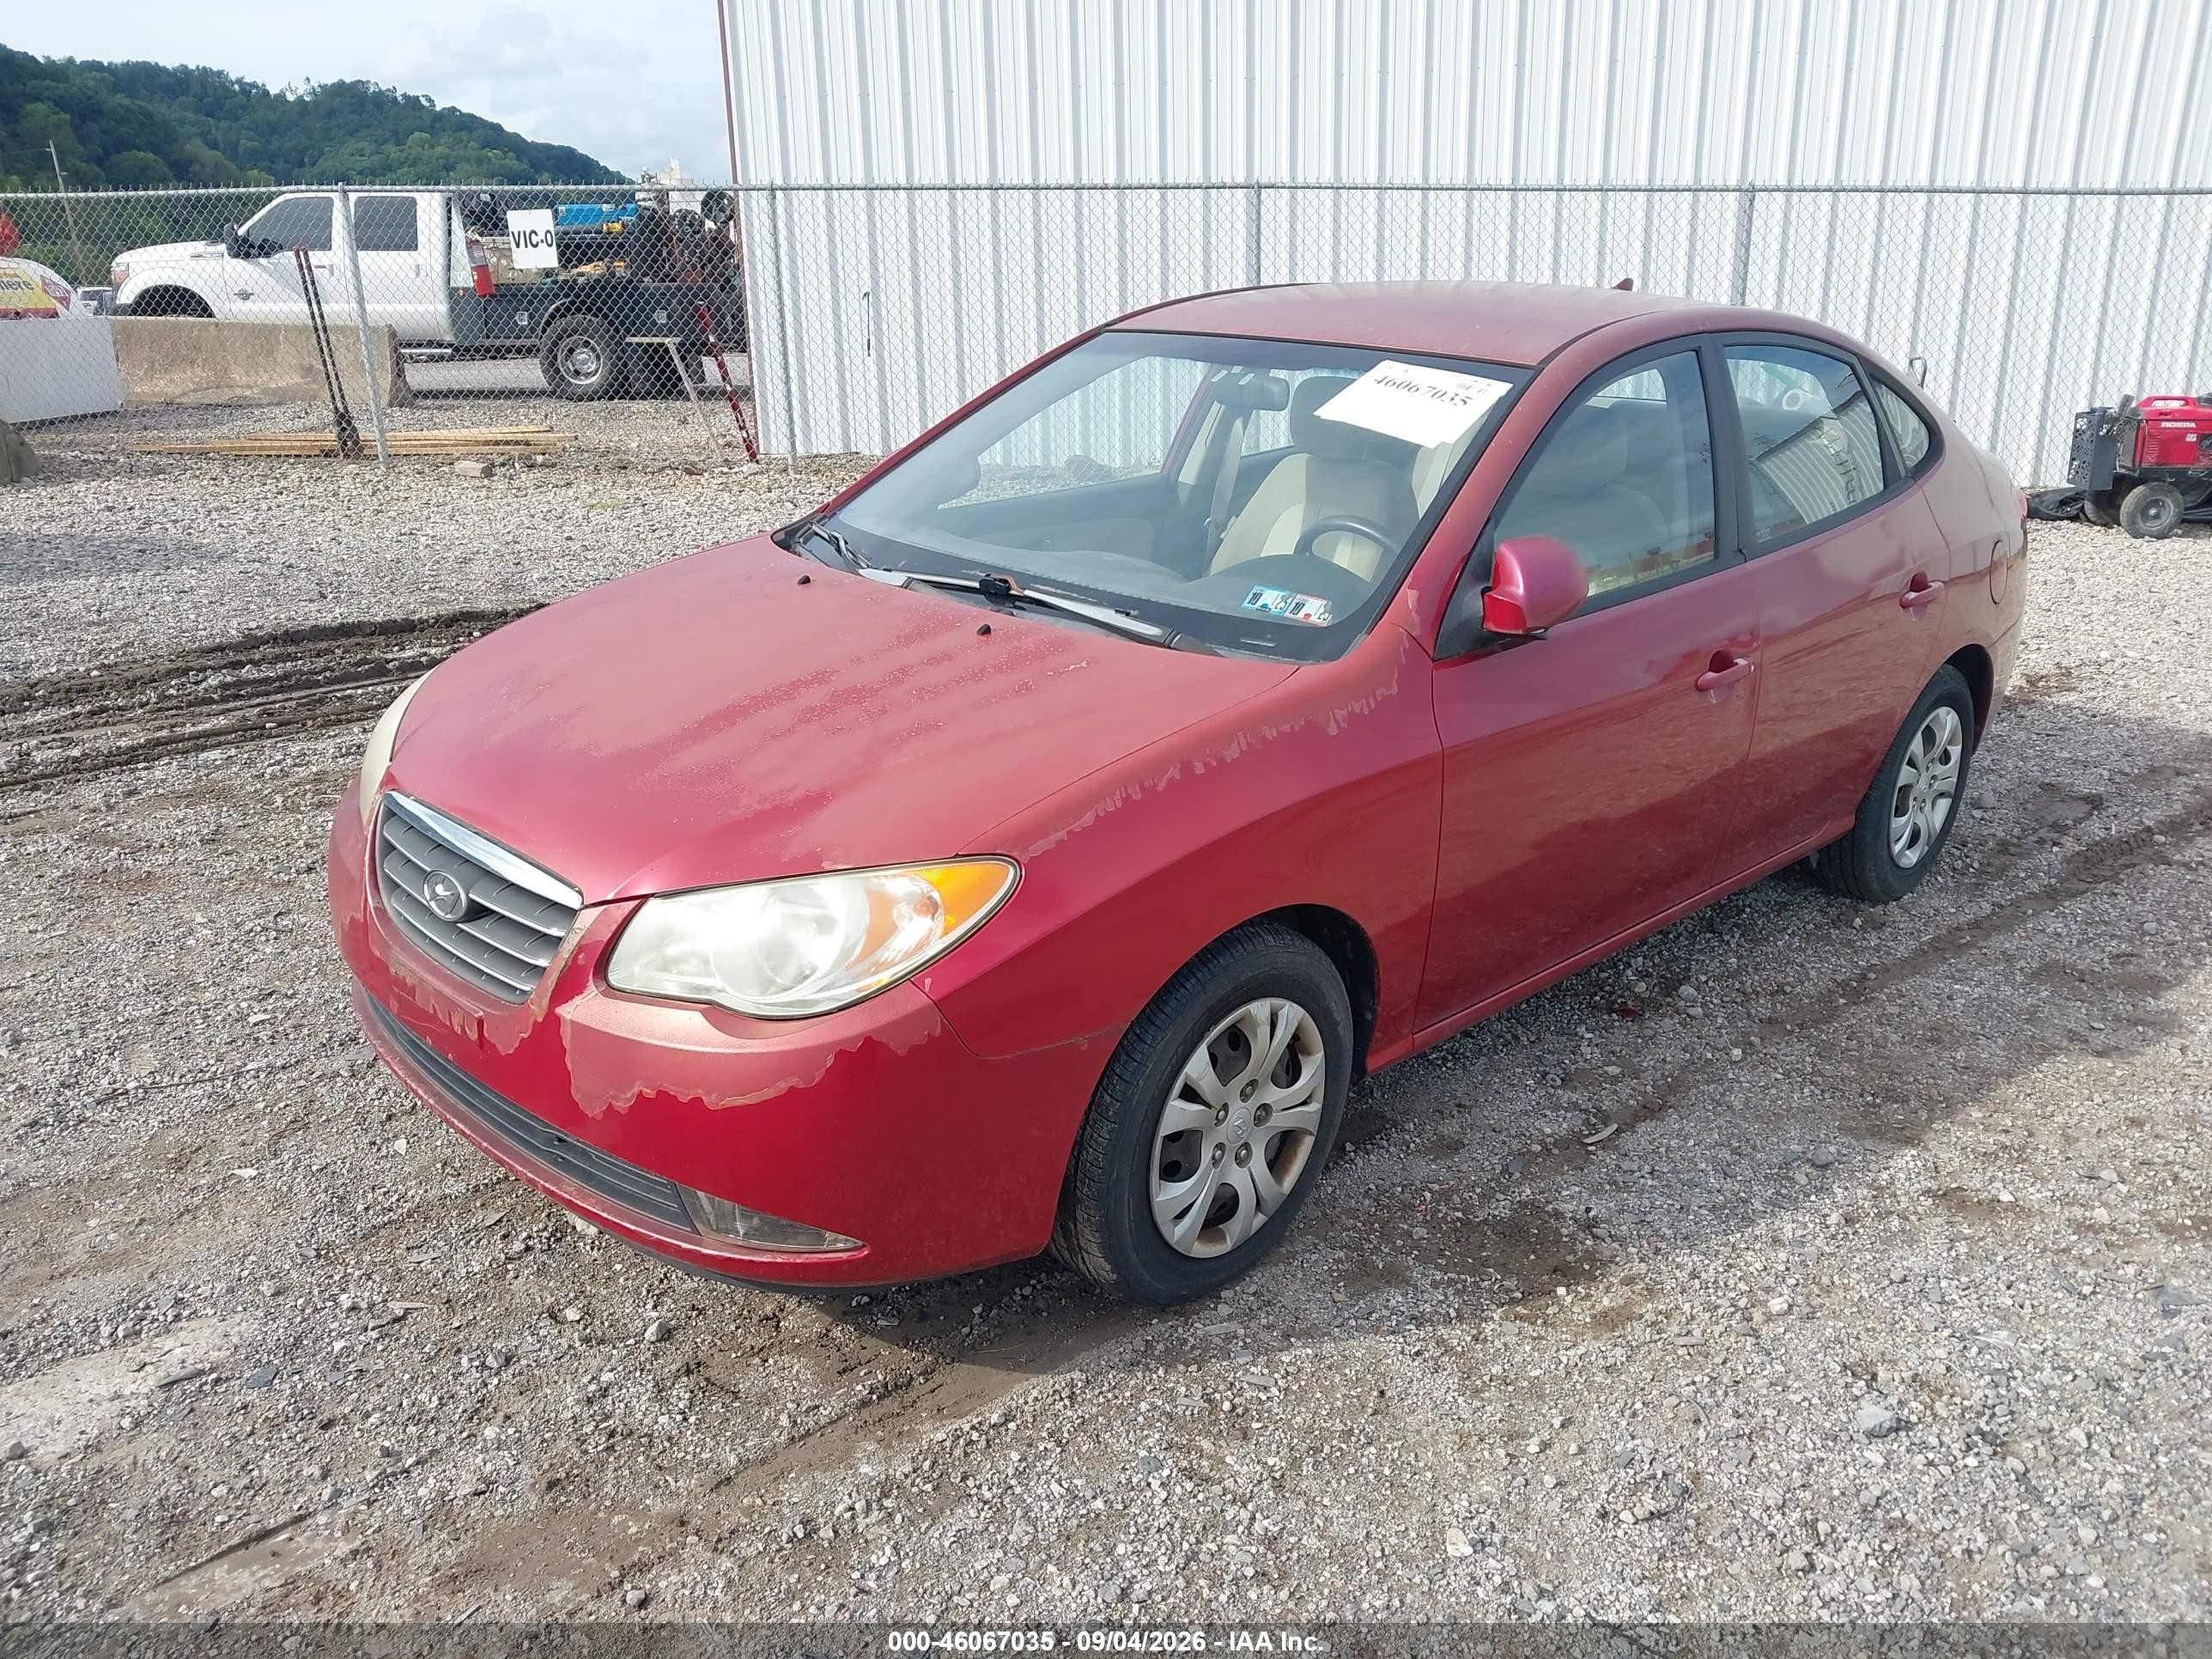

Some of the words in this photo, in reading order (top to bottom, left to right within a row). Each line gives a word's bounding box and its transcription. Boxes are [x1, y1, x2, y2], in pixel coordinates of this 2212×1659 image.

[1374, 375, 1474, 406] 46067035
[1248, 592, 1262, 605] 10
[1291, 603, 1305, 616] 10
